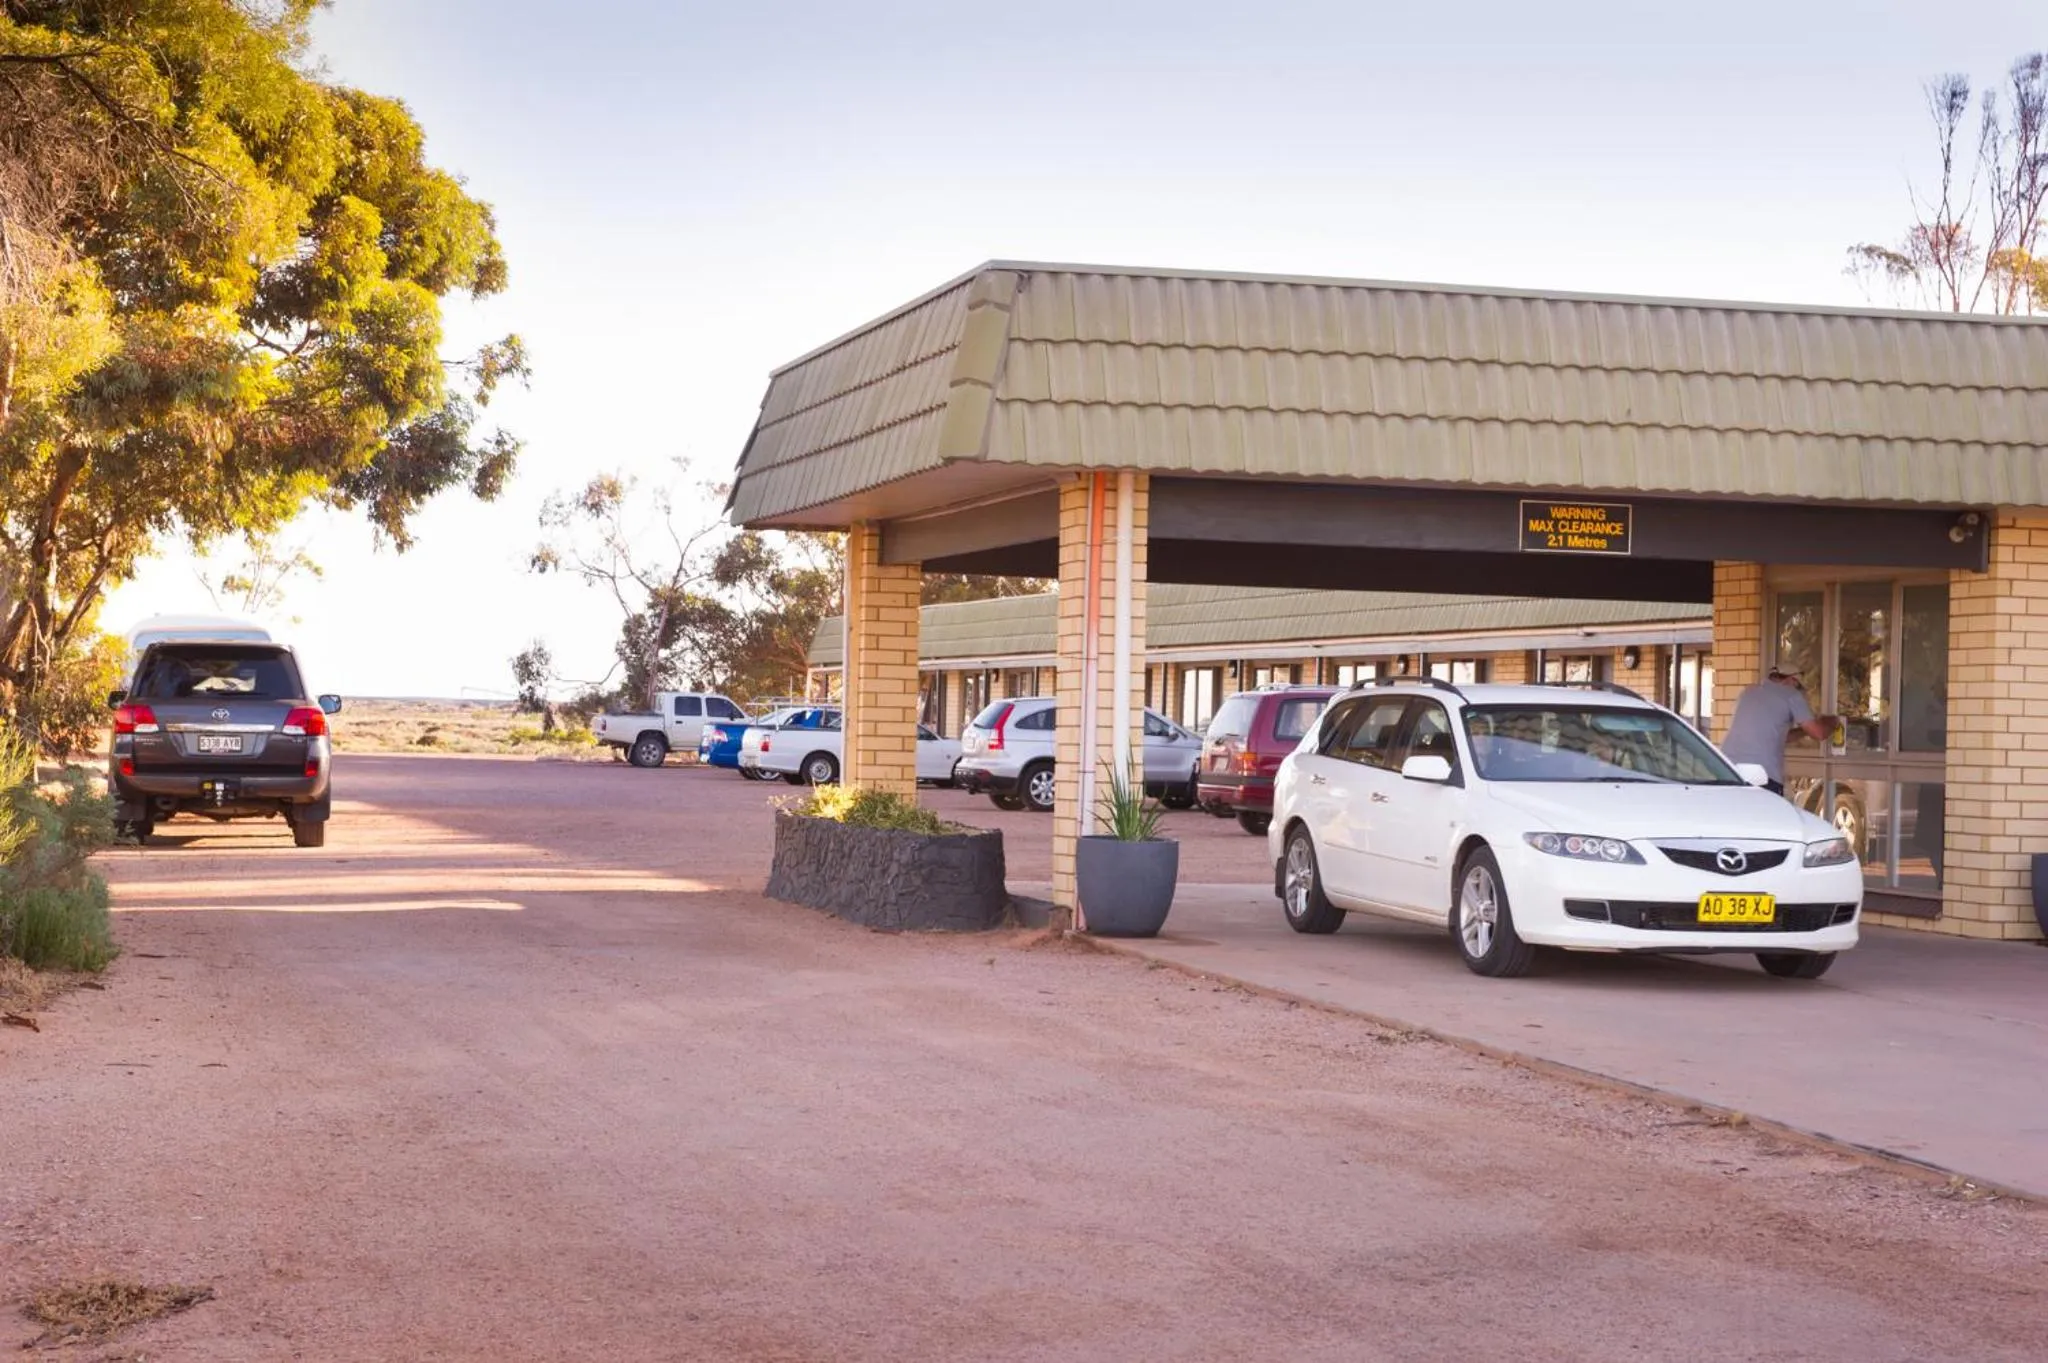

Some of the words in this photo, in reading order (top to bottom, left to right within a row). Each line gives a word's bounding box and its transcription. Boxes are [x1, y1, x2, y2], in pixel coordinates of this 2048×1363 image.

[1550, 506, 1606, 520] WARNING
[1528, 519, 1554, 533] MAX
[1558, 520, 1624, 535] CLEARANCE
[1547, 534, 1564, 547] 2.1
[1567, 535, 1608, 549] Metres
[1728, 897, 1747, 915] 38
[1752, 897, 1772, 916] XJ
